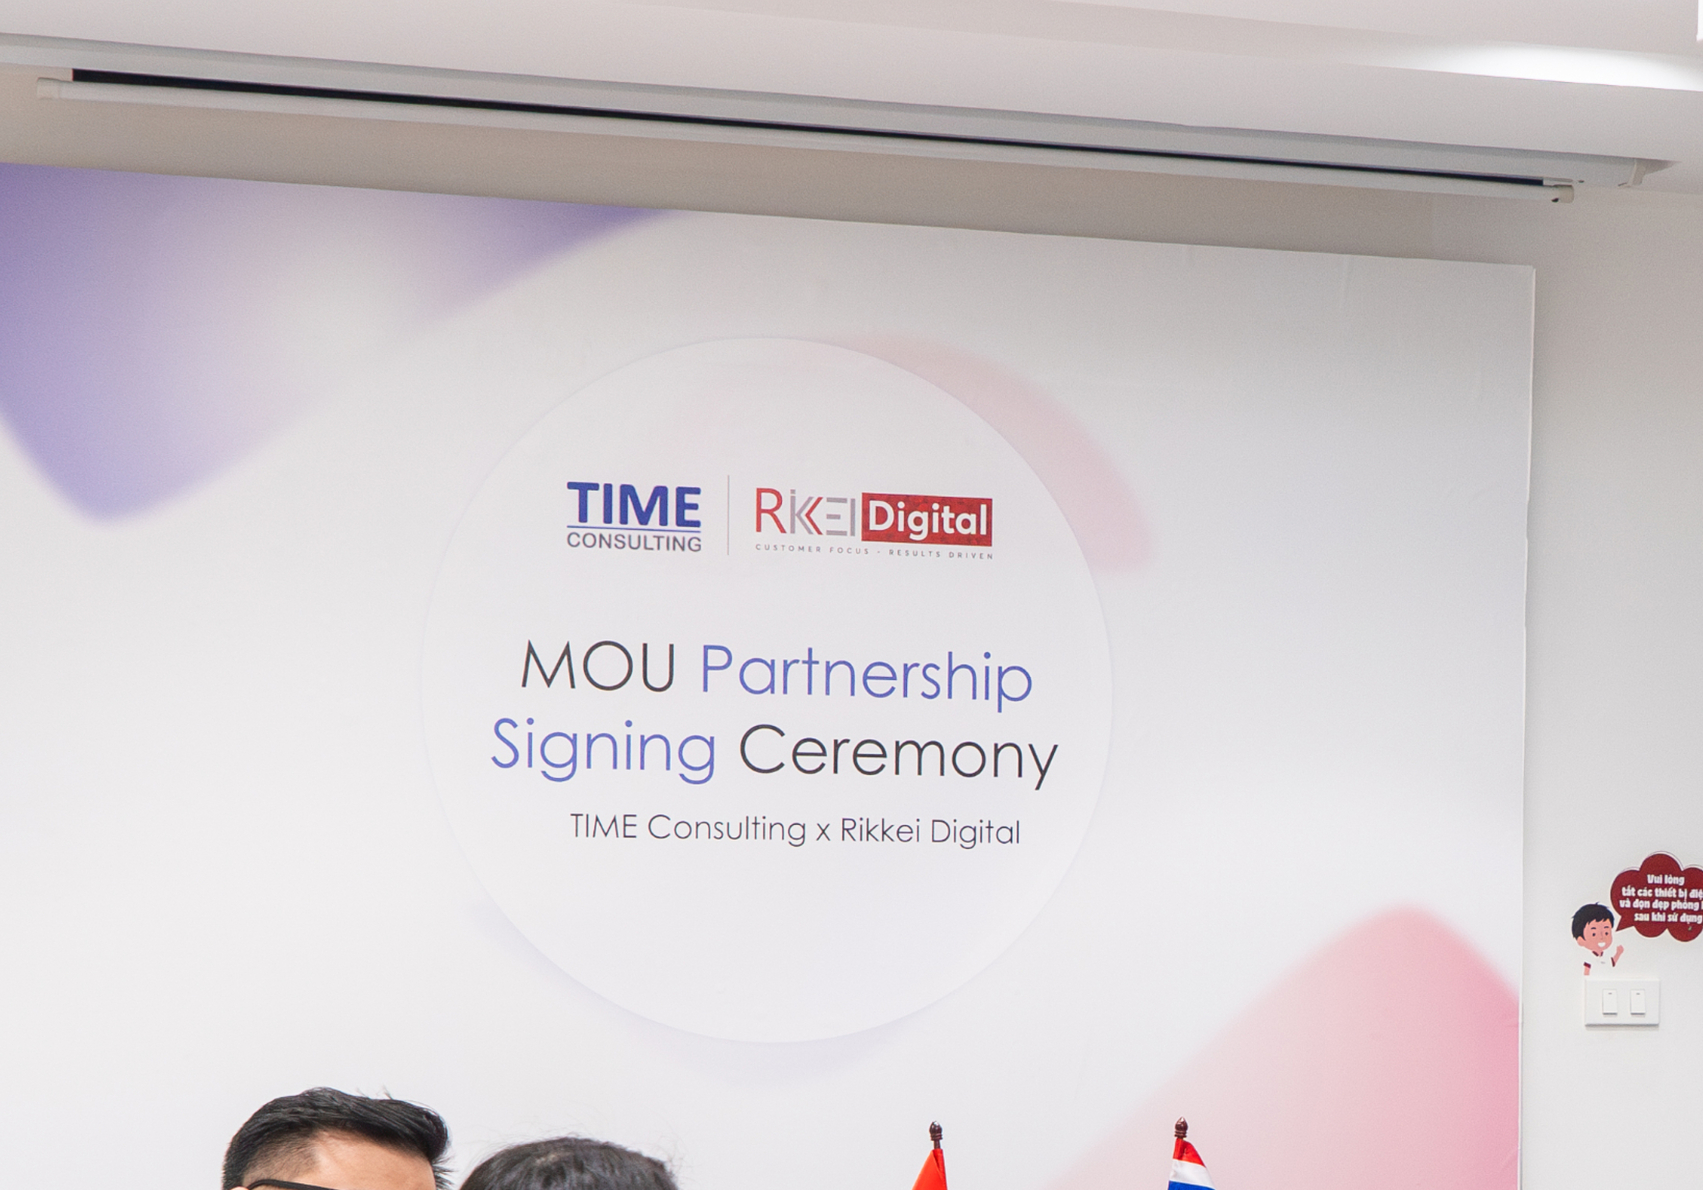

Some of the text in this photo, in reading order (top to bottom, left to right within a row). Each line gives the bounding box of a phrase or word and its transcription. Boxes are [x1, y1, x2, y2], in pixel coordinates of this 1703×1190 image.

[567, 481, 701, 527] TIME
[868, 498, 988, 540] Digital
[567, 531, 701, 552] CONSULTING
[755, 544, 994, 560] CUSTOMER FOCUS RESULTS DRIVEN
[521, 639, 1033, 712] MOU Partnership
[491, 717, 1058, 790] Signing Ceremony
[570, 813, 1021, 849] TIME Consulting x Rikkei Digital
[1647, 874, 1663, 884] Vui
